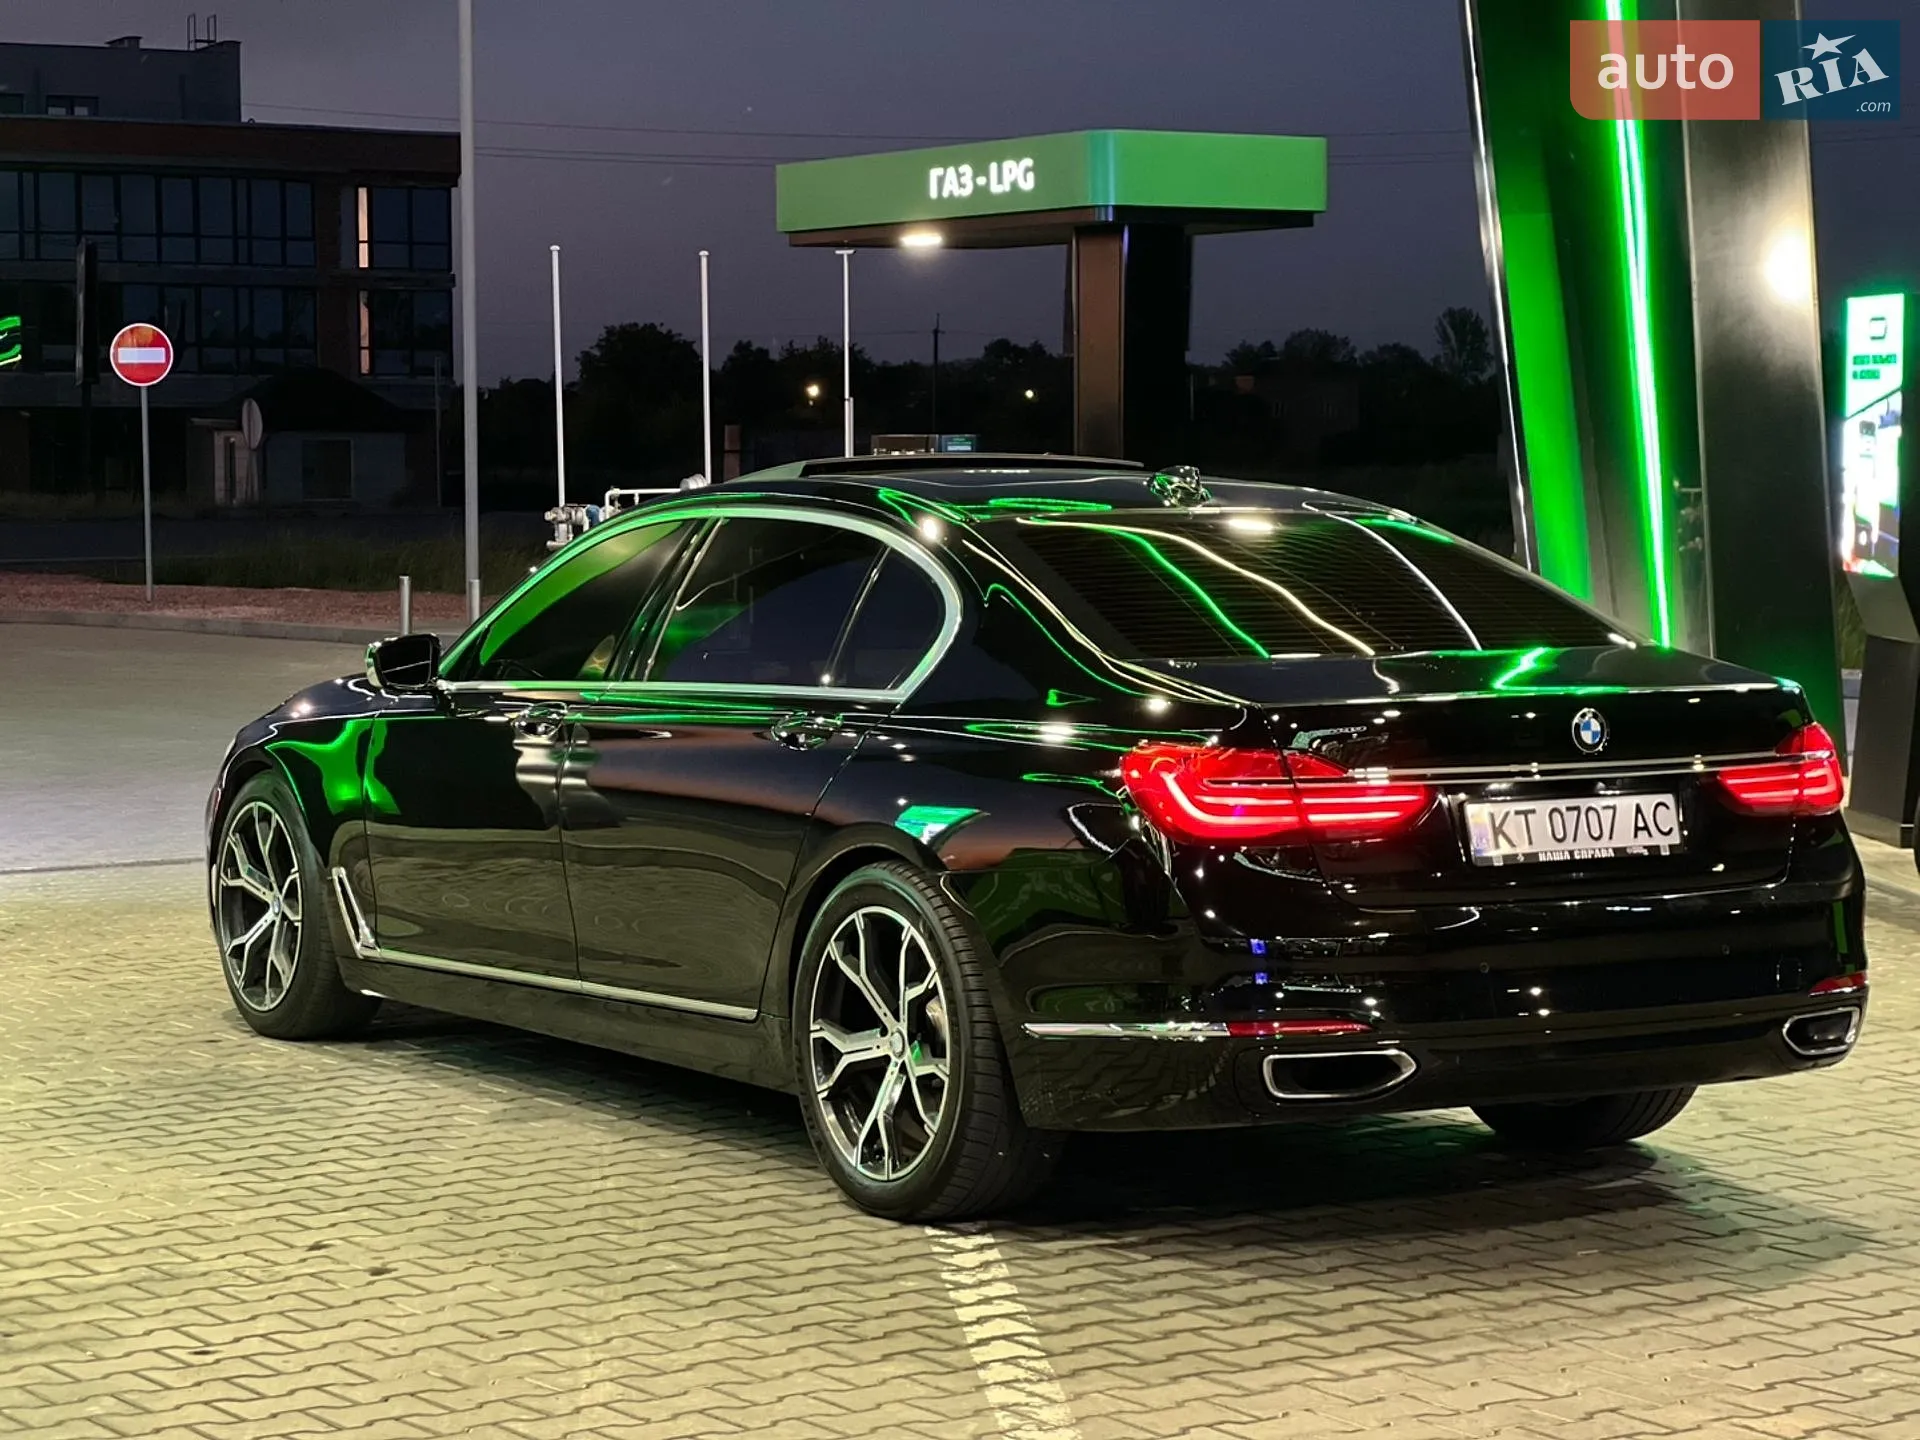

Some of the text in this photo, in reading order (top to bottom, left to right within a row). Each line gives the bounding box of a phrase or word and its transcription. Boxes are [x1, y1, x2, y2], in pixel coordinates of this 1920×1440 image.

[1489, 801, 1673, 849] KT 0707 AC
